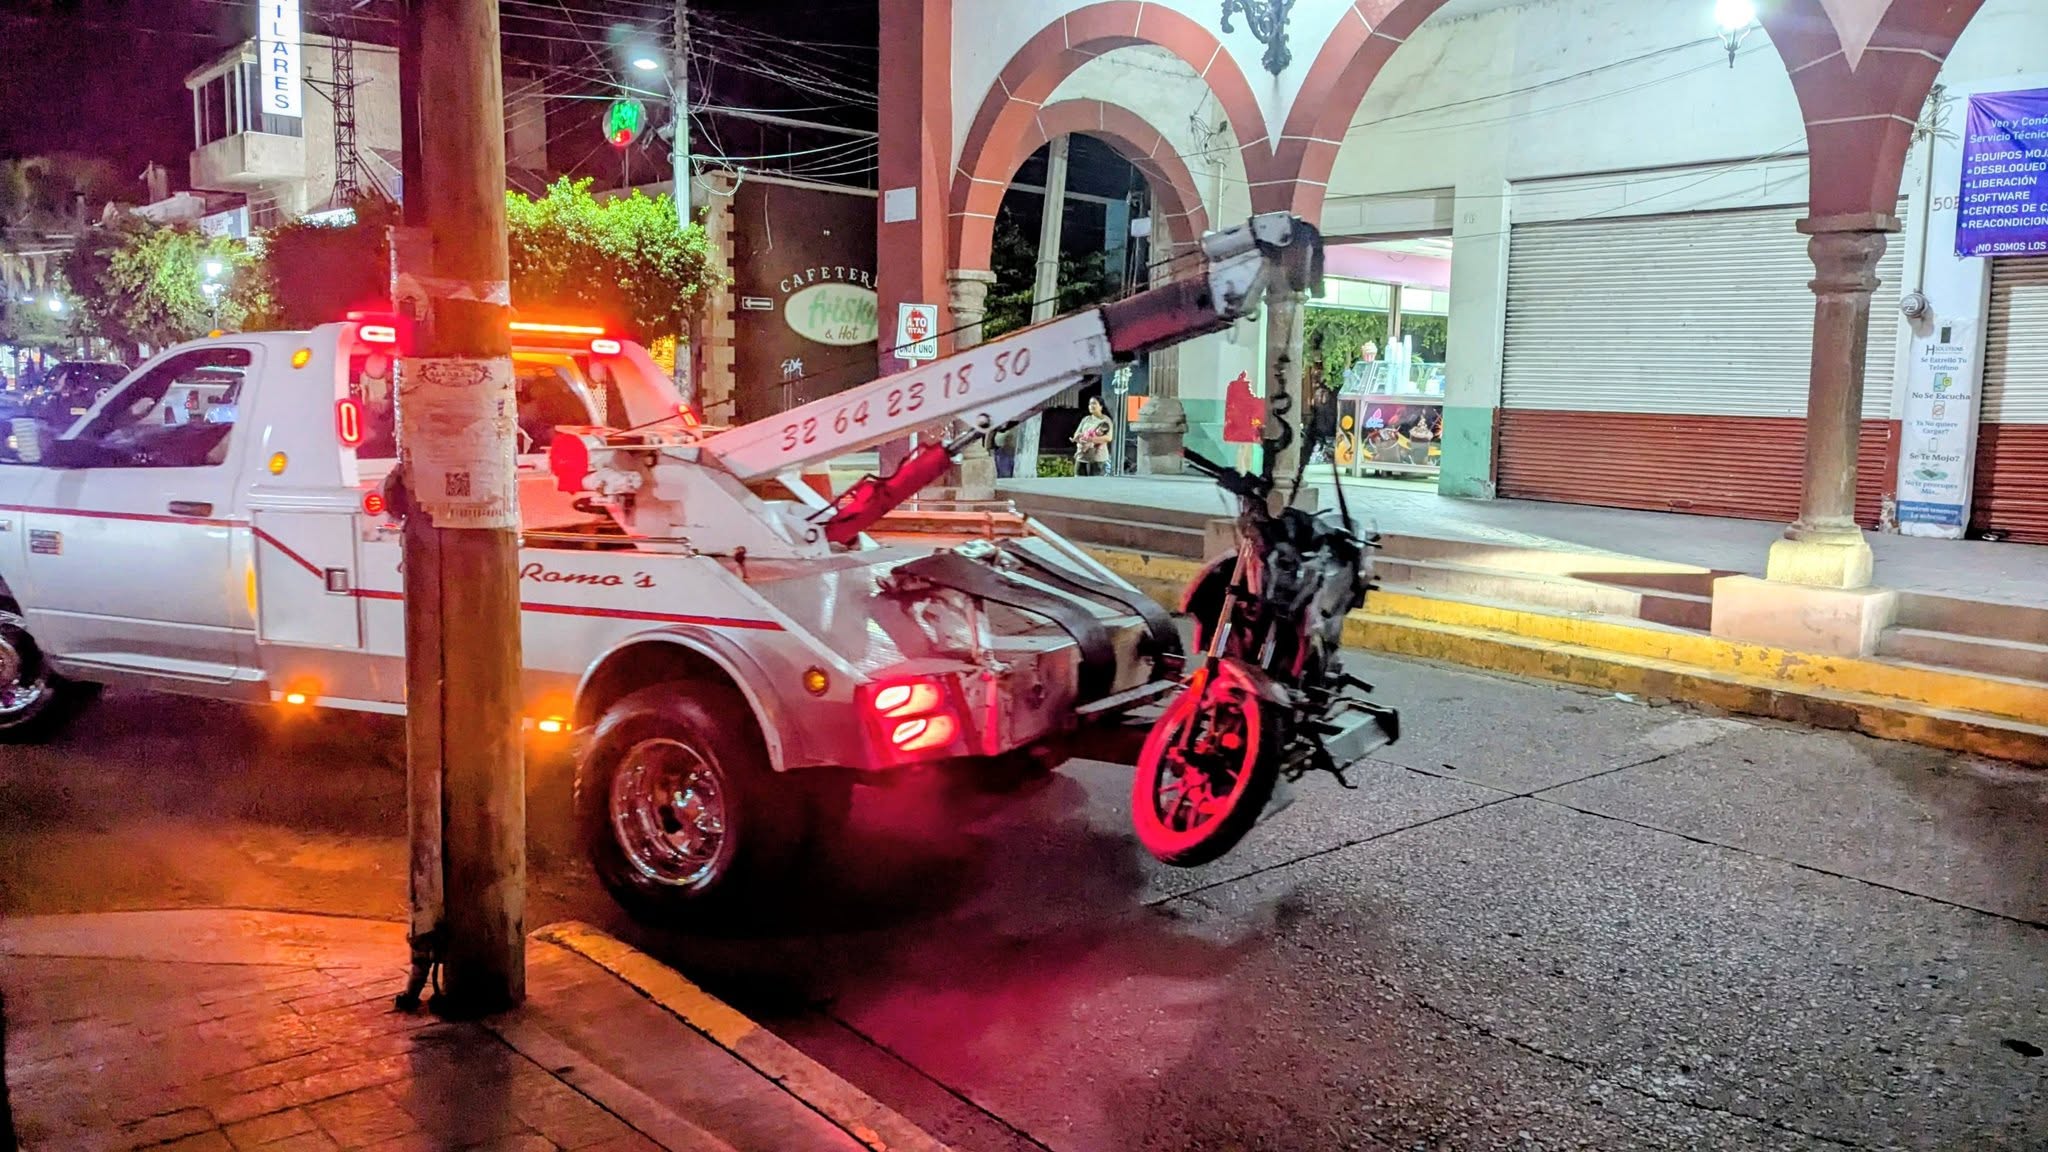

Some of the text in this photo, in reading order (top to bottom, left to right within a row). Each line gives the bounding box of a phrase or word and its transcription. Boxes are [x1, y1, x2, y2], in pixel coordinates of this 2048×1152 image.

[273, 0, 289, 109] ILARES
[1991, 114, 2048, 129] Ven y Conó
[1970, 130, 2048, 143] Servicio Técnic
[1975, 149, 2048, 162] EQUIPOS MOJ
[1973, 162, 2046, 175] DESBLOQUEO
[1972, 175, 2037, 189] LIBERACIÓN
[1970, 190, 2030, 202] SOFTWARE
[1969, 202, 2048, 215] CENTROS DE C
[1968, 217, 2048, 229] REACONDICION
[1993, 241, 2026, 252] SOMOS
[2028, 241, 2047, 251] LOS
[825, 324, 858, 340] & Hot
[918, 345, 933, 353] UNO
[1925, 344, 1935, 356] H
[781, 347, 1031, 452] 32 64 23 18 80
[1931, 454, 1960, 462] Mojo?
